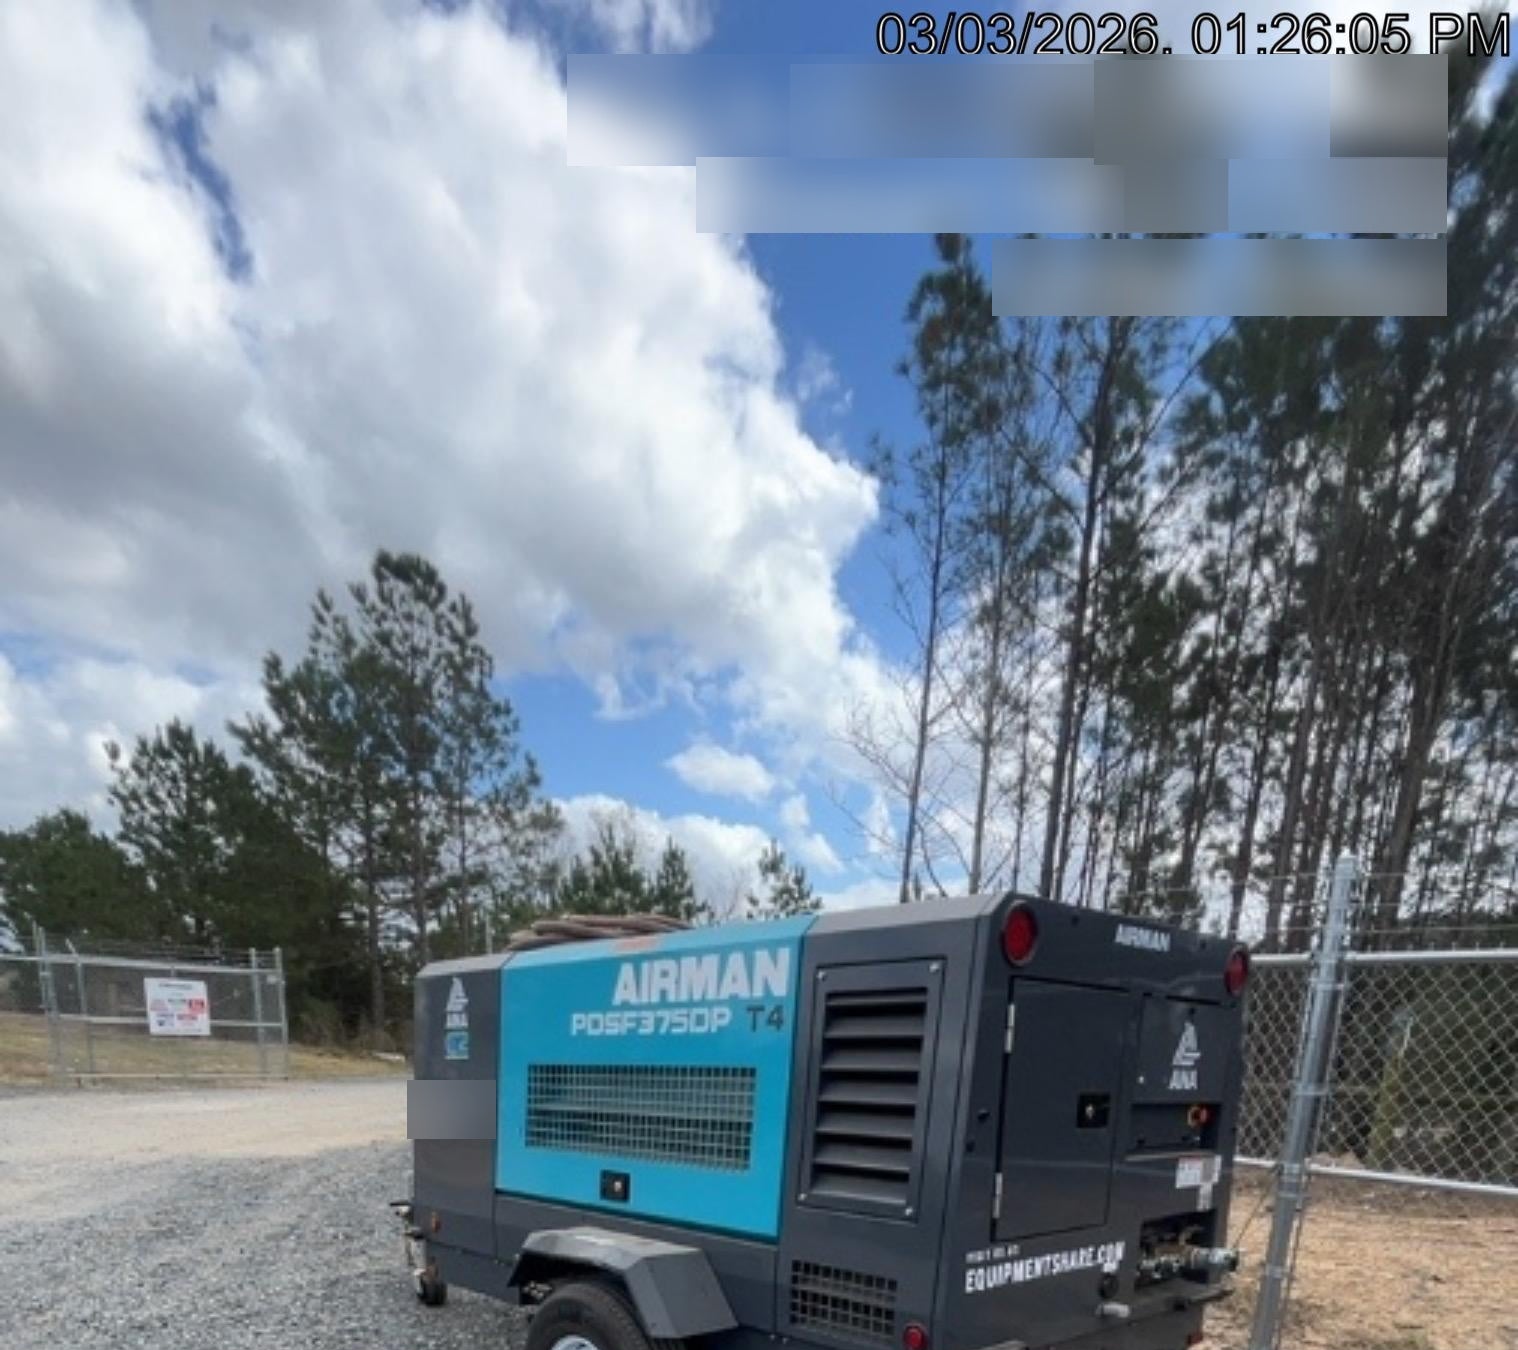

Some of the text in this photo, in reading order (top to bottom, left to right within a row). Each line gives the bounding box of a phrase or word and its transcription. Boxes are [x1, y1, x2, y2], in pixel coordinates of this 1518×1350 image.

[1115, 923, 1170, 952] AIRMAN
[612, 947, 790, 1006] AIRMAN
[746, 1004, 784, 1033] T4
